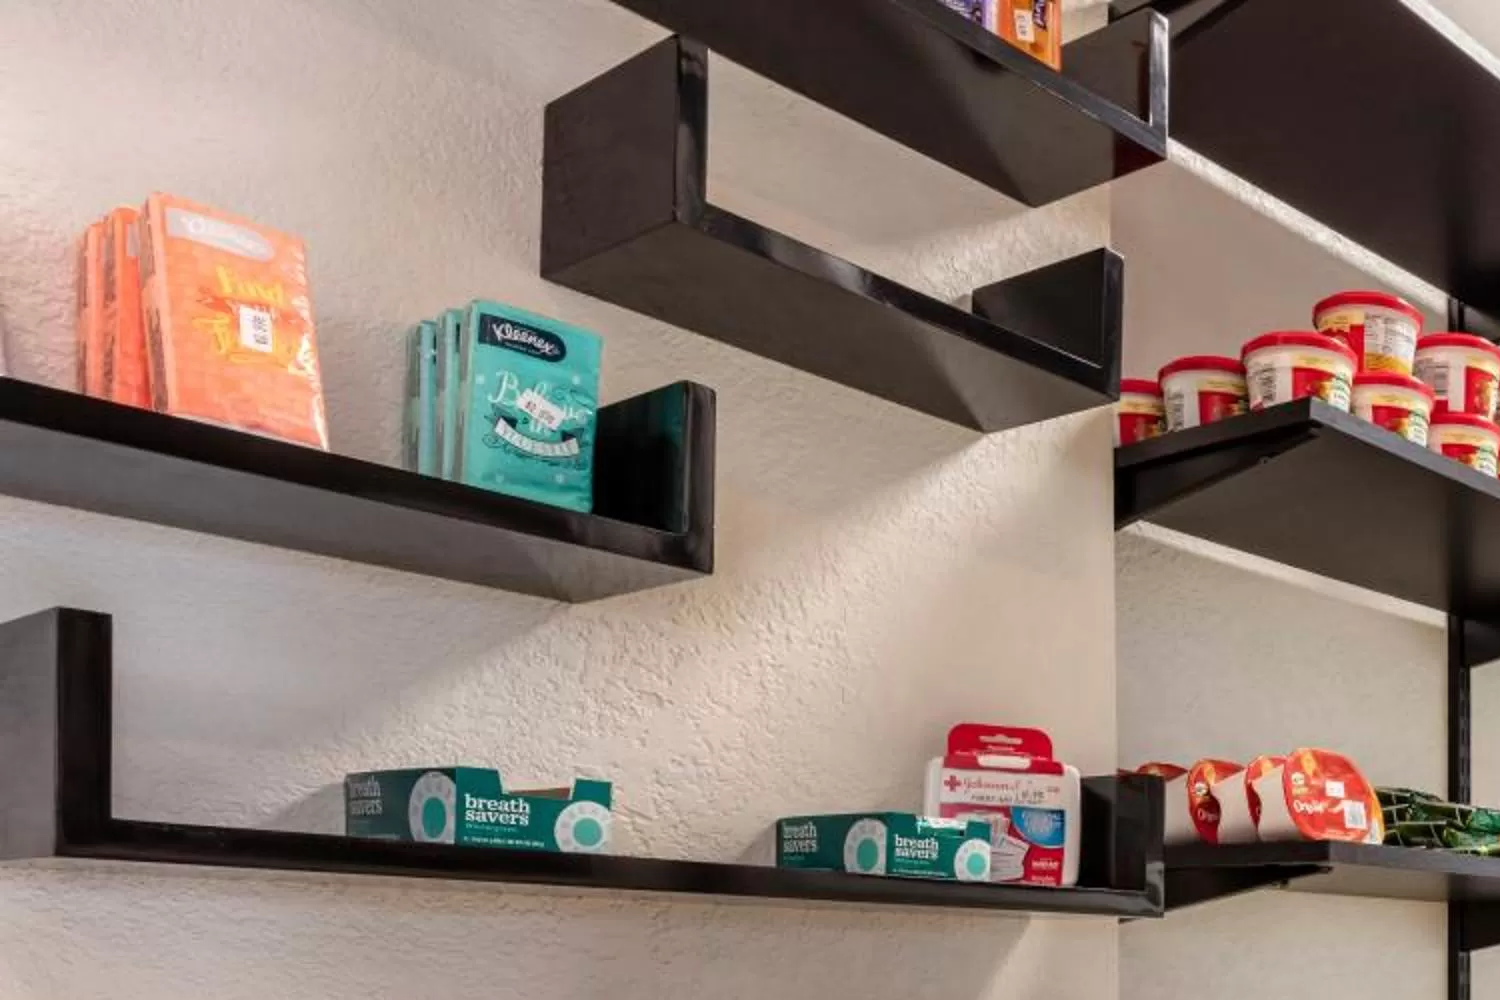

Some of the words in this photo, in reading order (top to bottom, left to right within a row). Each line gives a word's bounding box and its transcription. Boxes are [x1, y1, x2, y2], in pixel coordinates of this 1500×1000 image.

[491, 322, 558, 356] Kleenex
[464, 793, 531, 814] breath
[464, 809, 530, 826] savers
[783, 820, 817, 838] breath
[895, 833, 940, 851] breath
[895, 847, 938, 860] savers
